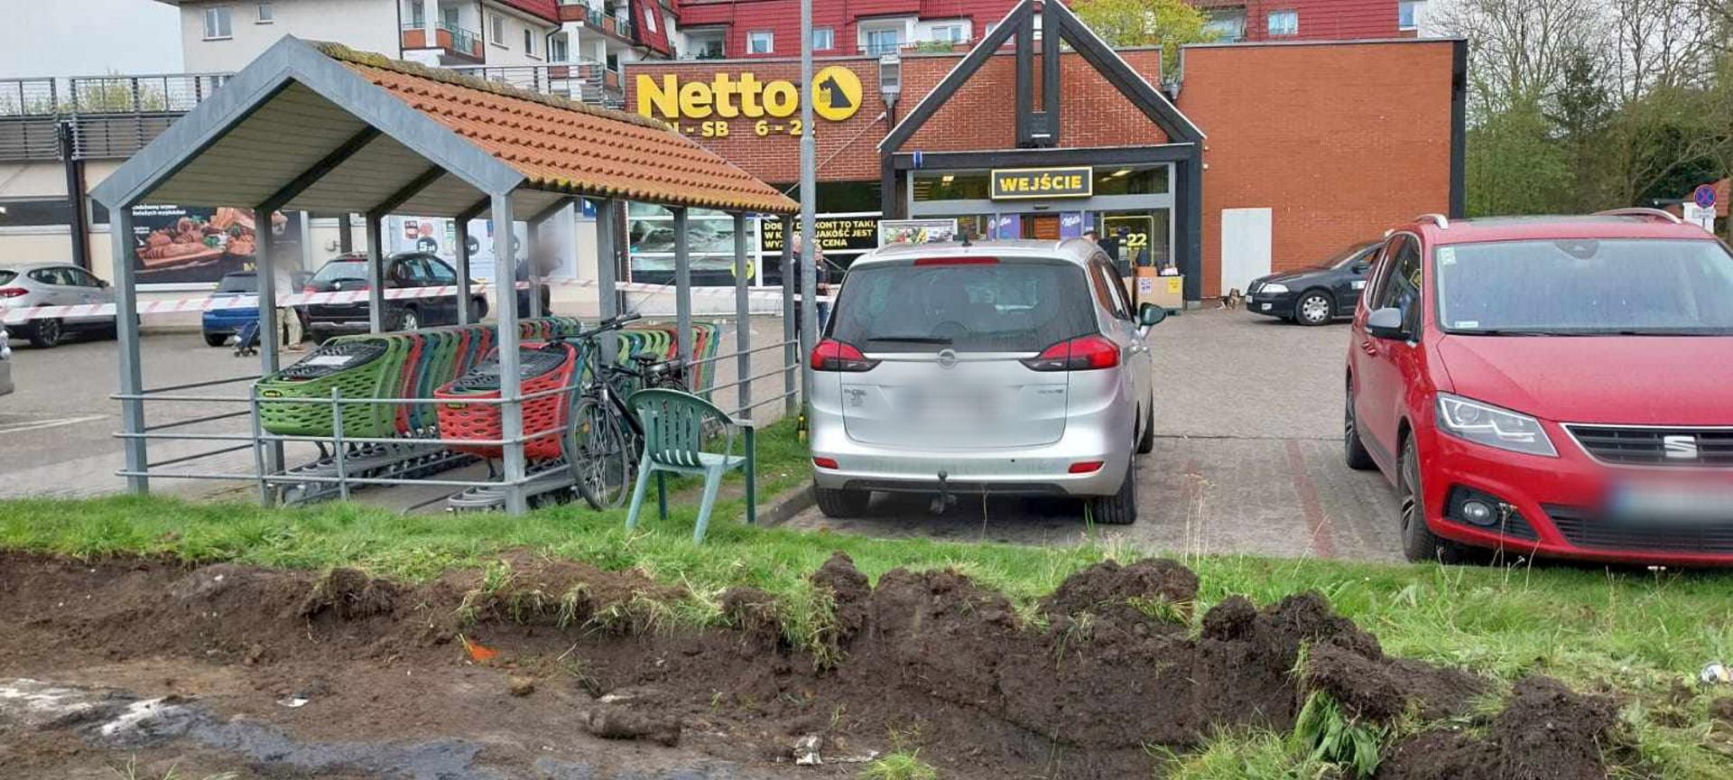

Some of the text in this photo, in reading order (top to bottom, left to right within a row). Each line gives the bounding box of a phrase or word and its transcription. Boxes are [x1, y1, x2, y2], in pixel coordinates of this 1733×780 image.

[636, 72, 799, 119] Netto
[702, 120, 729, 137] SB
[755, 120, 769, 136] 6
[789, 119, 816, 136] 2
[999, 172, 1083, 192] WEJŚCIE
[764, 231, 774, 239] W
[852, 228, 873, 238] JEST
[840, 221, 852, 229] TO
